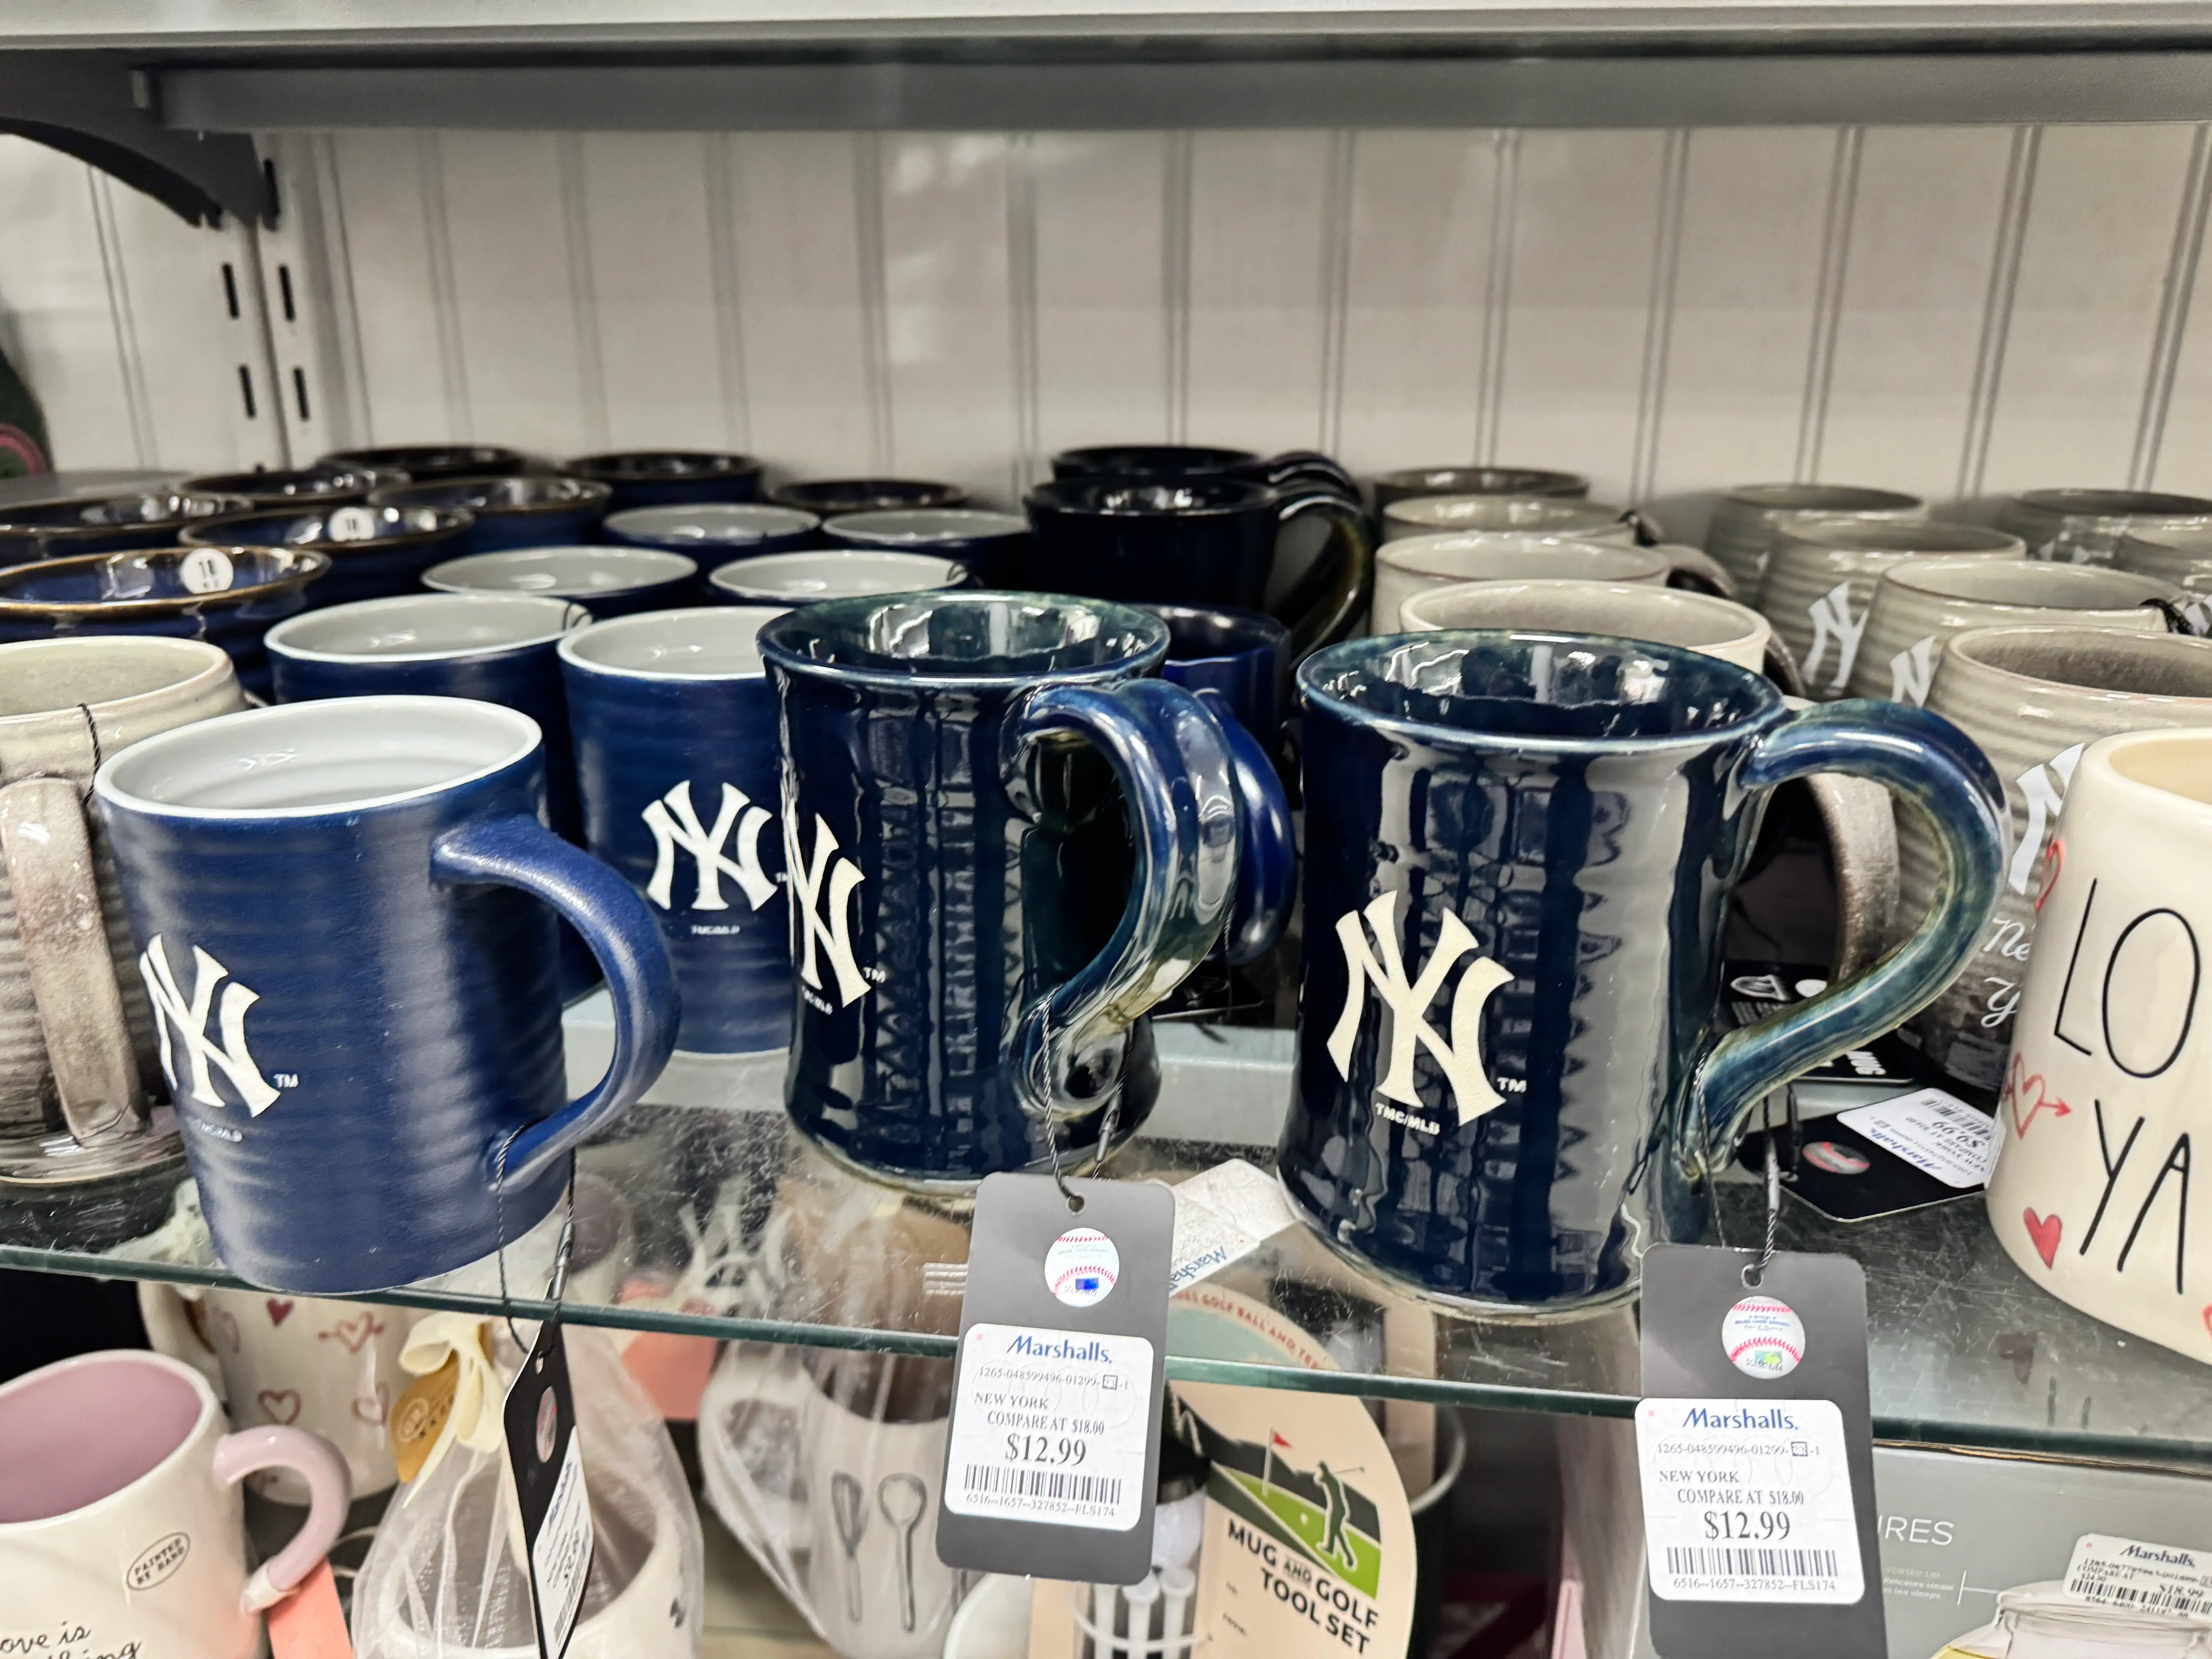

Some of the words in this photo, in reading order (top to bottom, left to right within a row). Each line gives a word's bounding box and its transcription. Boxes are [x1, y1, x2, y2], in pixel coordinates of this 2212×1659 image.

[642, 780, 778, 911] NY
[780, 778, 872, 1008] NY
[1983, 916, 2036, 961] Ne
[863, 967, 886, 983] TM
[1327, 890, 1515, 1126] NY
[140, 933, 281, 1118] NY
[273, 1073, 299, 1088] TM
[1497, 1077, 1527, 1092] TM
[2080, 1099, 2191, 1294] YA
[974, 1392, 1007, 1406] NEW
[1010, 1395, 1049, 1410] YORK
[988, 1410, 1048, 1430] COMPARE
[1050, 1416, 1068, 1431] AT
[1072, 1418, 1105, 1435] $18.00
[1005, 1432, 1087, 1467] $12.99
[1659, 1470, 1693, 1482] NEW
[1696, 1471, 1740, 1483] YORK
[1677, 1488, 1743, 1504] COMPARE
[1745, 1490, 1763, 1504] AT
[1769, 1490, 1804, 1506] $18.00
[1704, 1510, 1791, 1541] $12.99
[1228, 1517, 1277, 1567] MUG
[1283, 1558, 1312, 1583] AND
[1316, 1578, 1379, 1628] GOLF
[1260, 1566, 1321, 1626] TOOL
[1325, 1613, 1370, 1655] SET
[0, 1633, 51, 1654] ove
[58, 1620, 92, 1646] is
